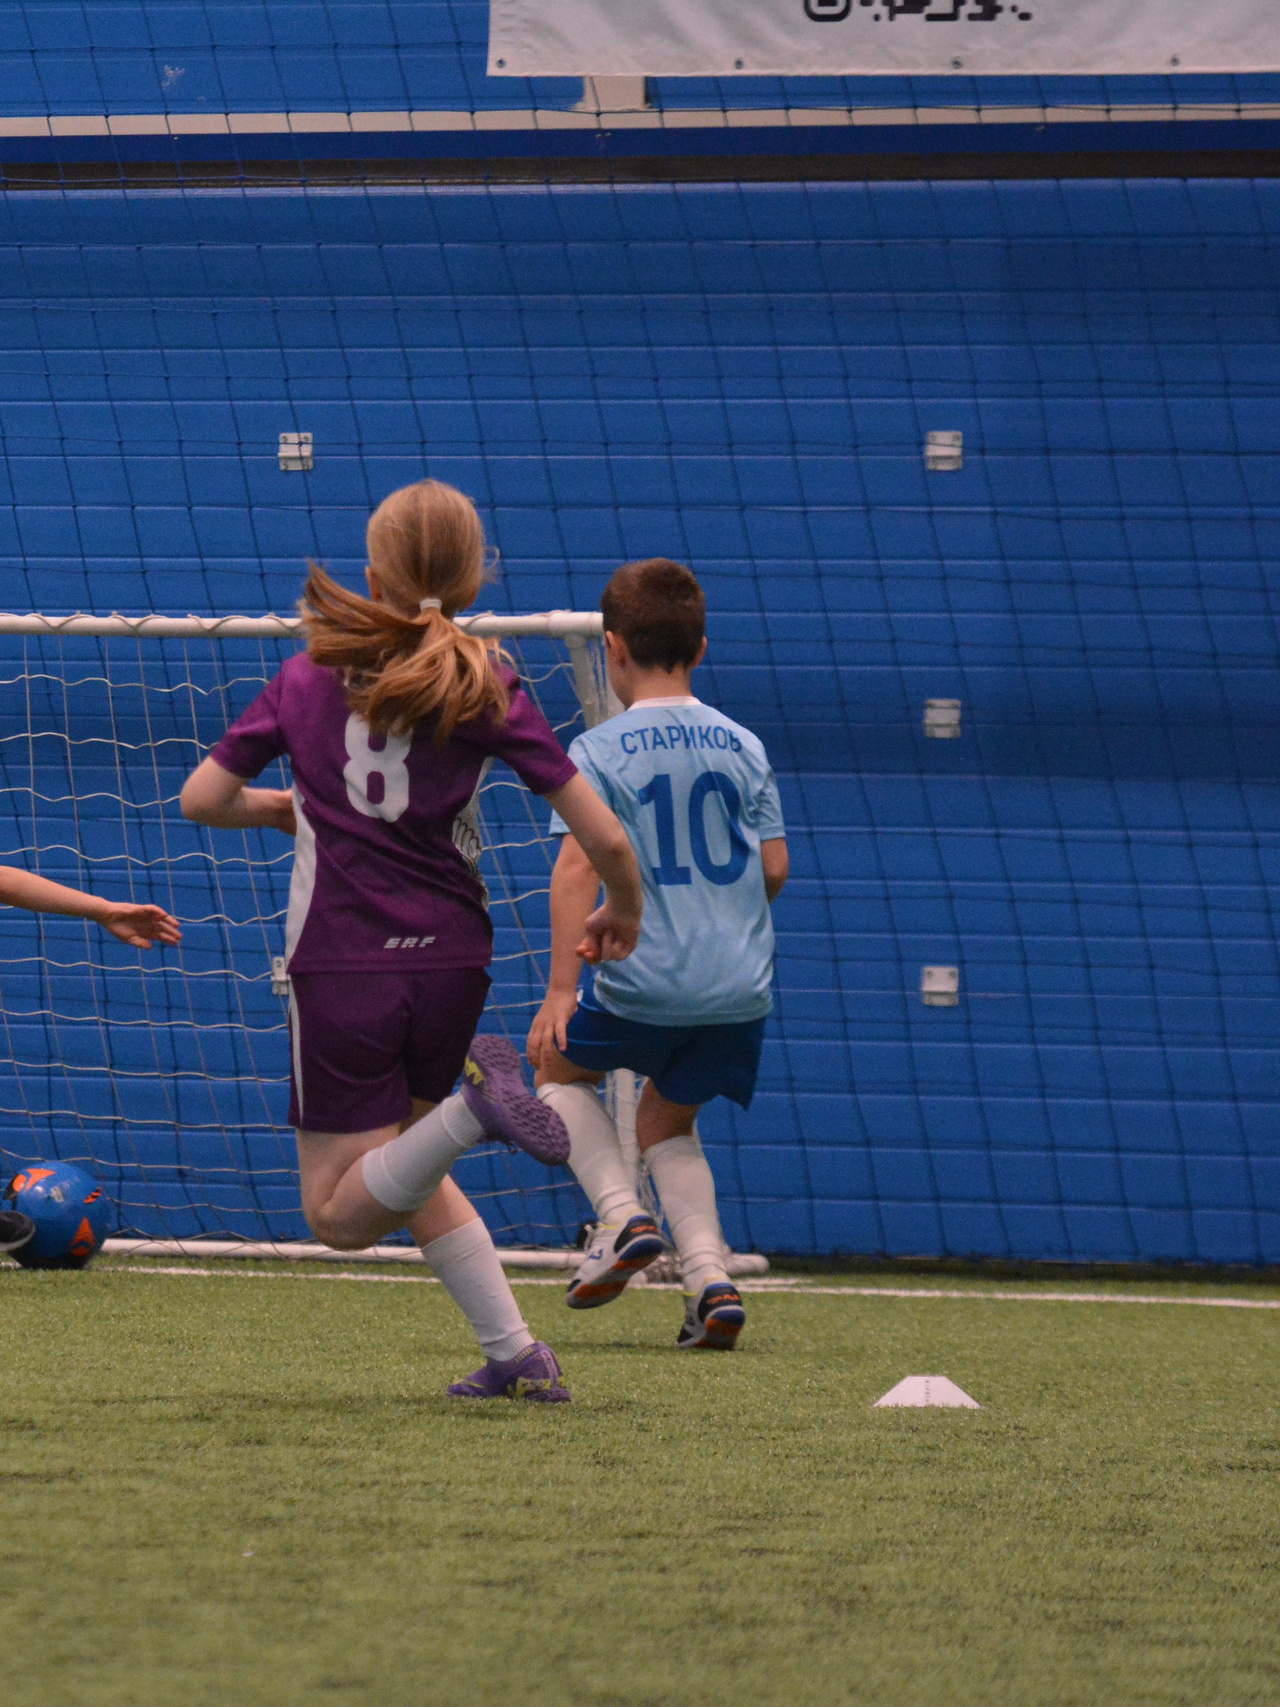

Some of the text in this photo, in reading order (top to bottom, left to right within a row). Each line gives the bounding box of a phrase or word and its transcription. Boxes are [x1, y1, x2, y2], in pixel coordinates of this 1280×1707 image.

[343, 710, 413, 823] 8
[620, 724, 743, 755] СТАРИКОВ
[638, 770, 750, 886] 10
